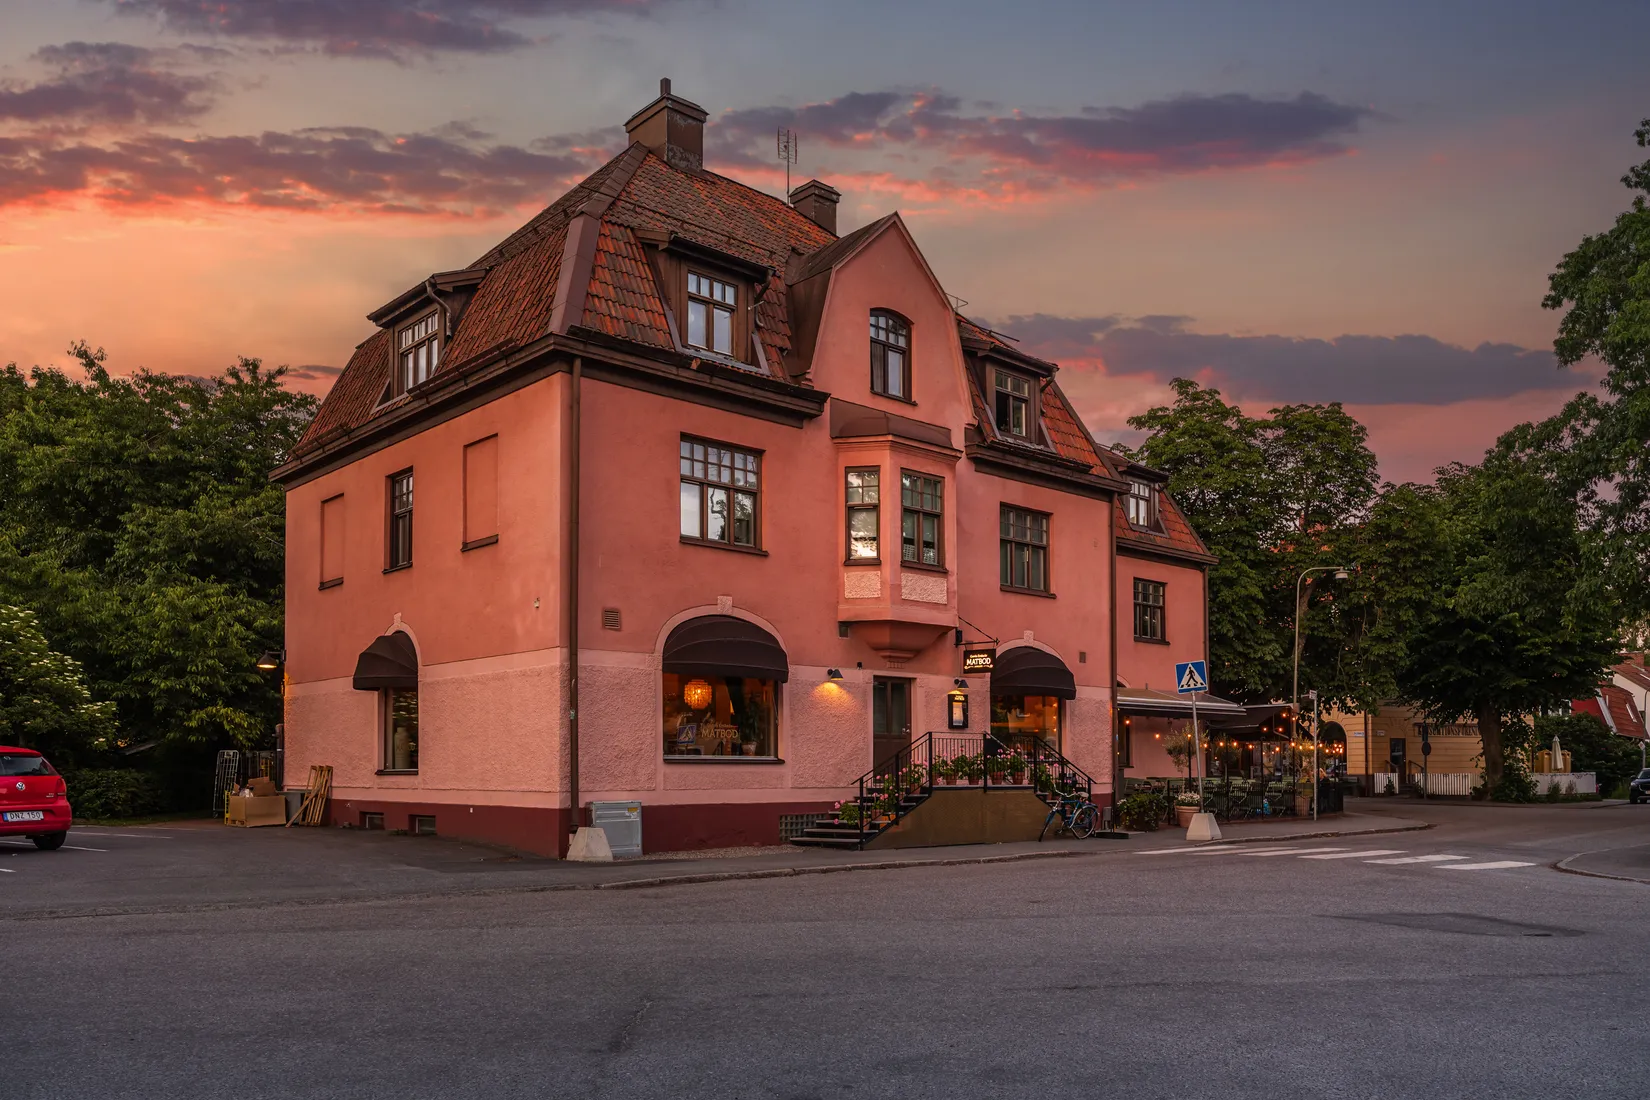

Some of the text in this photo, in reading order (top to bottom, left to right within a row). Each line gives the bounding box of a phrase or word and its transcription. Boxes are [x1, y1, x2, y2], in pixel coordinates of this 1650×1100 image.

[967, 657, 991, 665] MATBOD
[702, 728, 738, 738] MATBOD
[27, 811, 41, 819] 150
